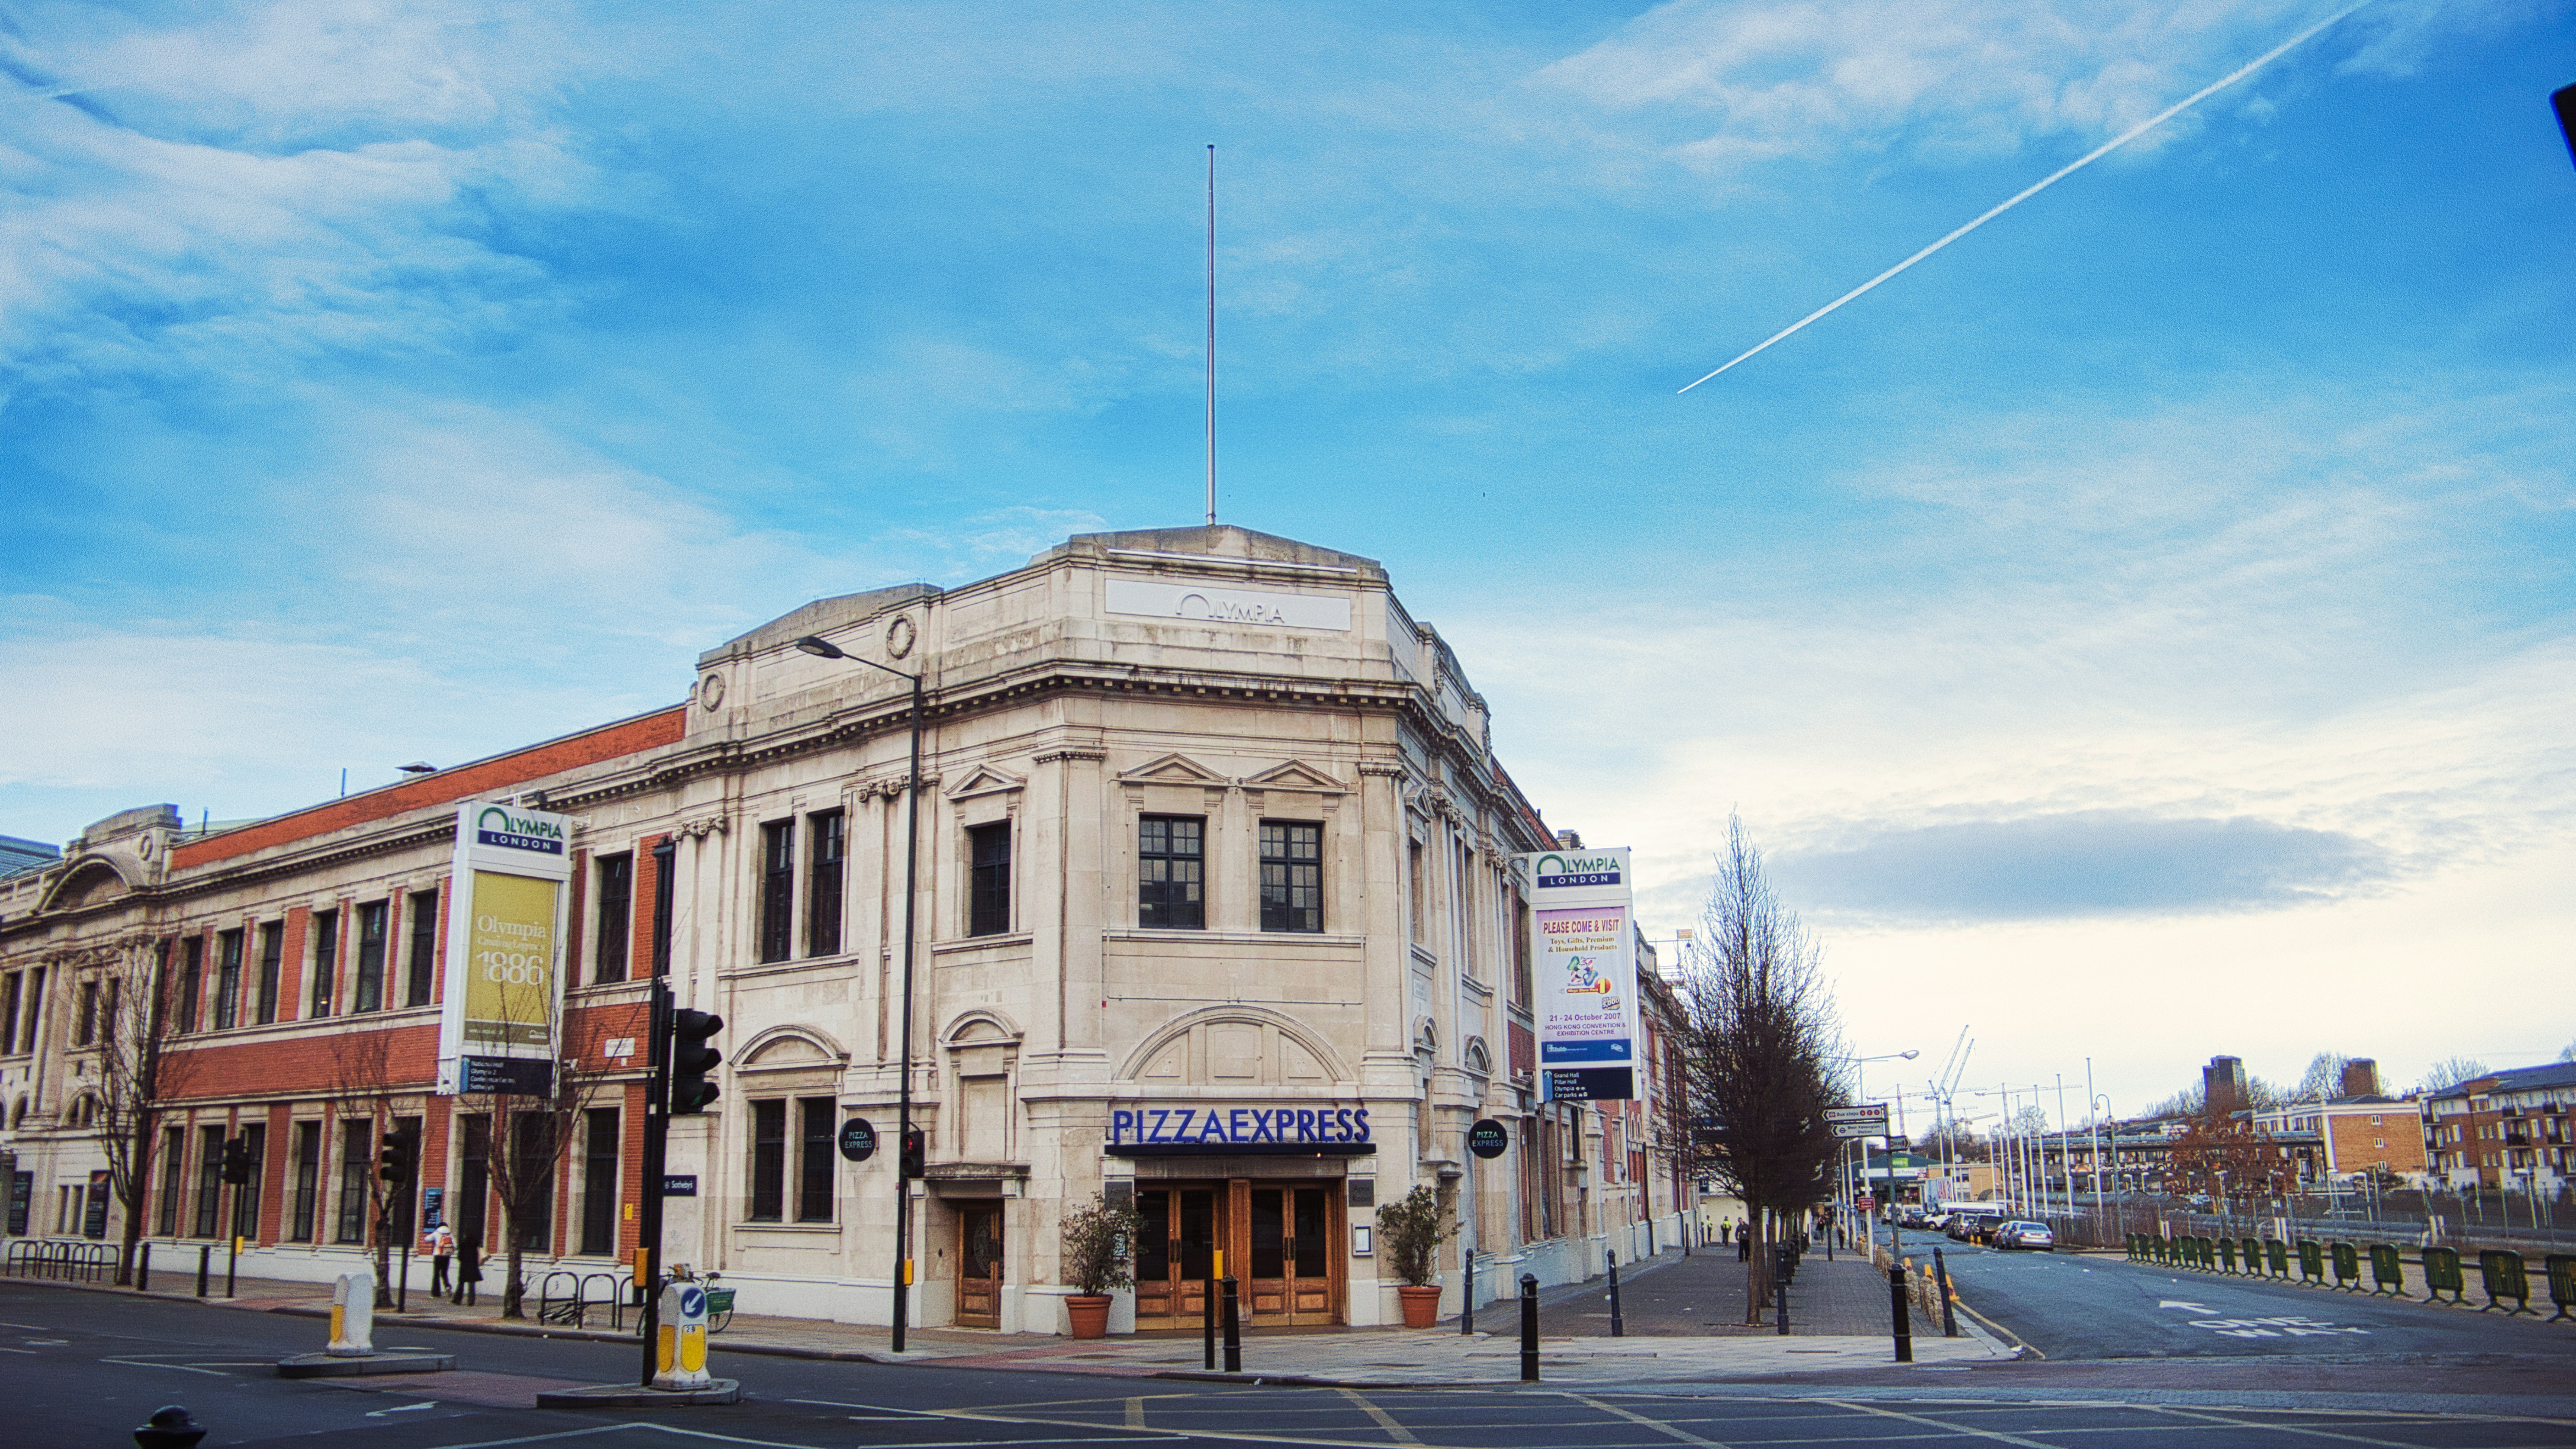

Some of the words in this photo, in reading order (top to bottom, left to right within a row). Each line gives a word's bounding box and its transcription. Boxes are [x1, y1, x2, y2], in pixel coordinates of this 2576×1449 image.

[1175, 589, 1285, 623] OLYMPIA
[478, 807, 563, 840] OLYMPIA
[491, 834, 551, 850] LONDON
[1537, 854, 1620, 875] OLYMPIA
[1550, 875, 1608, 885] LONDON
[477, 915, 546, 941] Olympia
[1543, 921, 1570, 934] PLEASE
[1572, 920, 1592, 933] COME
[1594, 920, 1599, 932] &
[1601, 919, 1619, 932] VISIT
[476, 951, 544, 986] 1886
[1598, 978, 1606, 994] 1
[1113, 1108, 1370, 1143] PIZZAEXPRESS
[845, 1140, 872, 1148] EXPRESS
[2188, 1317, 2334, 1327] ONE
[2215, 1327, 2371, 1337] WAY
